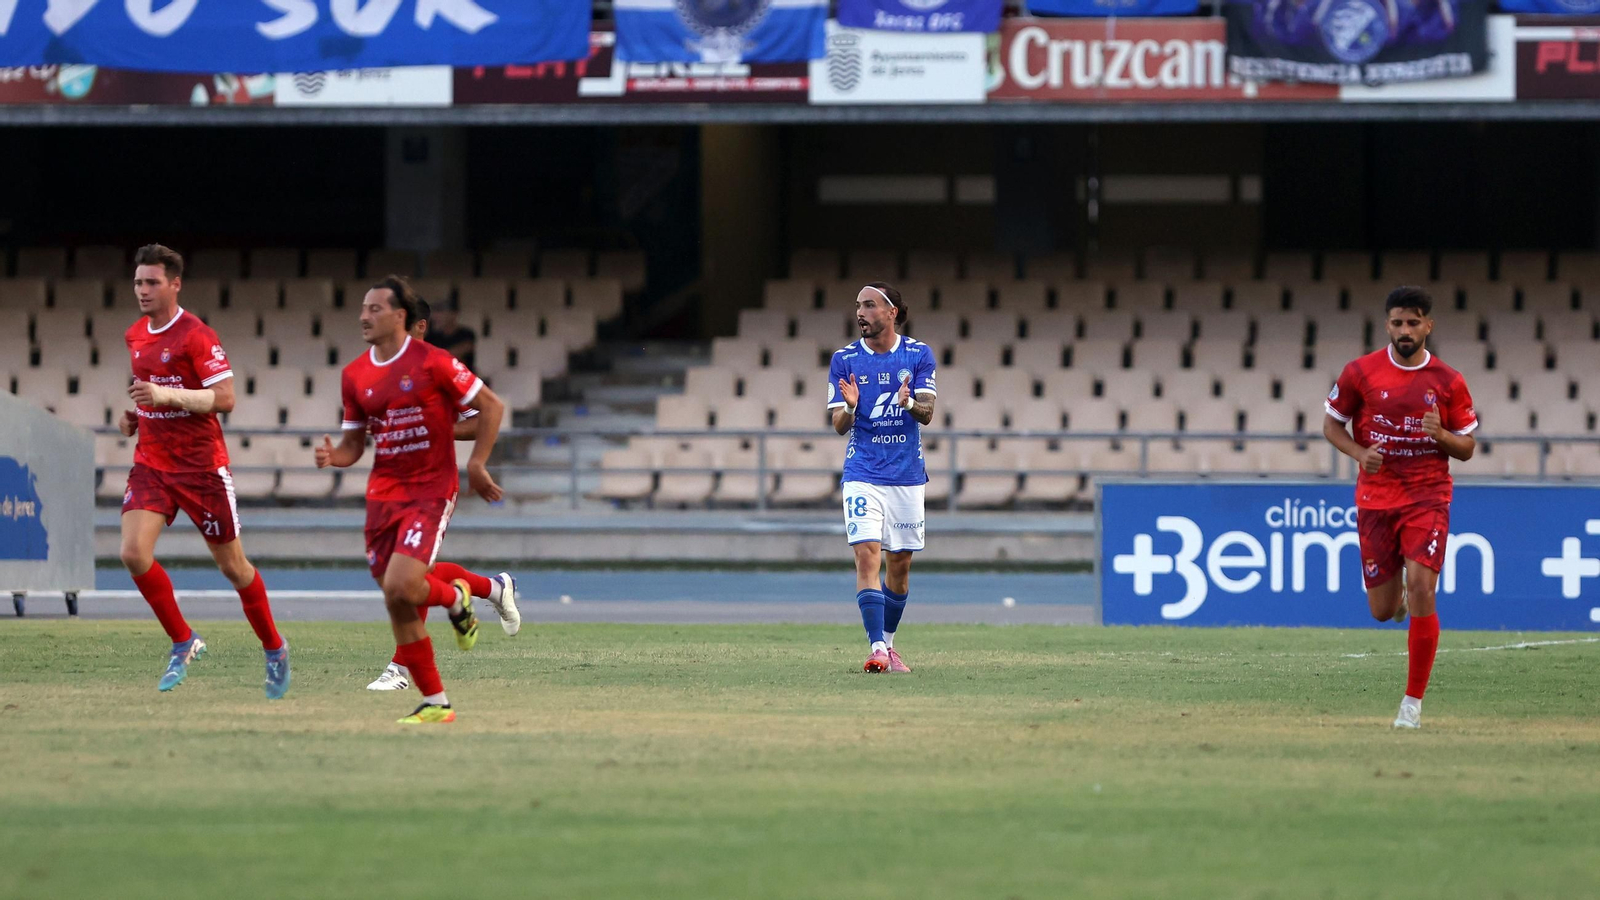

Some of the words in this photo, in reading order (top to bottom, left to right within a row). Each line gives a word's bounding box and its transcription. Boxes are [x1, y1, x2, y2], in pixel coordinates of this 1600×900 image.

[1009, 27, 1258, 97] Cruzcam
[1536, 41, 1600, 74] PL
[150, 375, 182, 383] Ricardo
[884, 404, 904, 418] Air
[845, 496, 868, 518] 18
[202, 519, 221, 537] 21
[403, 529, 422, 548] 14
[1427, 539, 1438, 556] 4
[1156, 516, 1495, 620] Beimn
